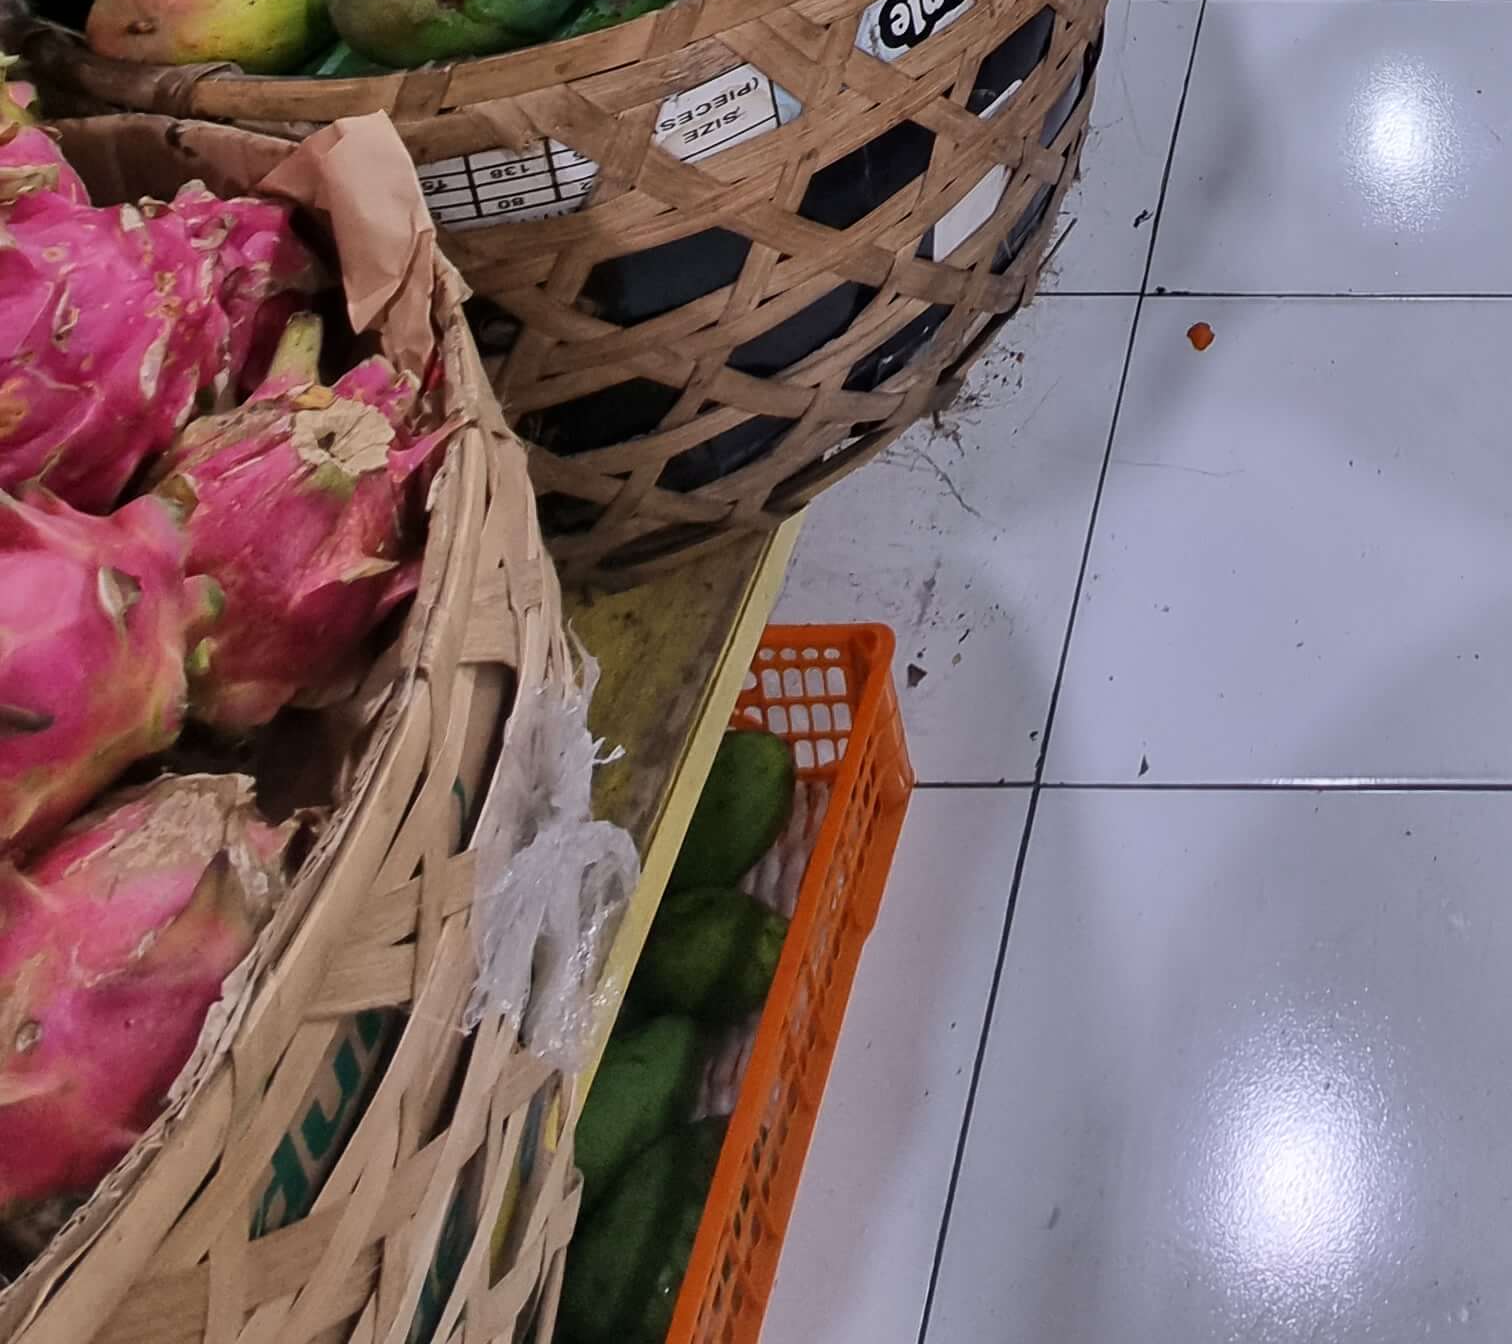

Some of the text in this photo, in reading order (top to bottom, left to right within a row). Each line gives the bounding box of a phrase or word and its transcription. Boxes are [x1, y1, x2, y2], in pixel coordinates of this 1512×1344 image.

[659, 76, 759, 132] (PIECES
[682, 107, 741, 144] SIZE
[489, 163, 531, 180] 138
